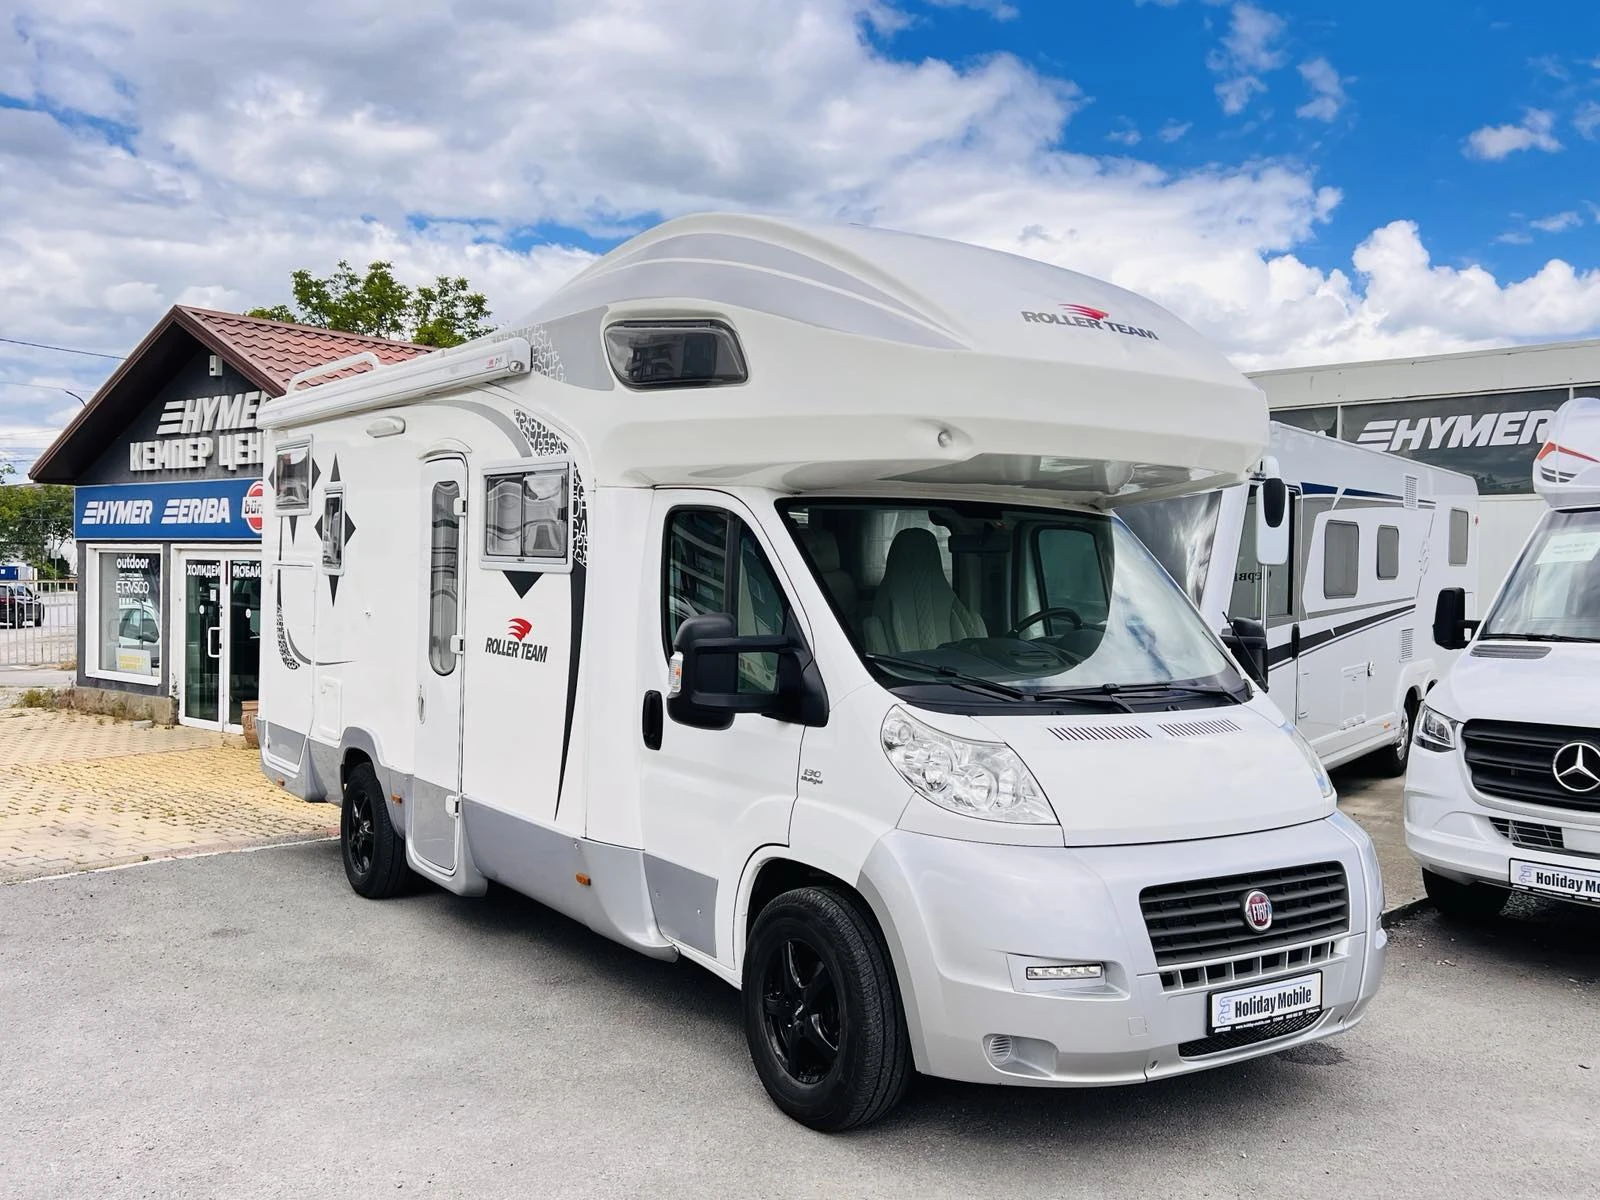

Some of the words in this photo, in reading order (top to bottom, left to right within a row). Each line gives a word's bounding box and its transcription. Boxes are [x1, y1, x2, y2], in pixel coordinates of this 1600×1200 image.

[1020, 310, 1103, 330] ROLLER
[1103, 320, 1160, 341] TEAM
[1389, 409, 1556, 451] HYMER
[129, 436, 214, 471] КЕМПЕР
[218, 431, 264, 471] ЦЕН
[95, 499, 153, 525] HYMER
[177, 497, 231, 524] ERIBA
[116, 554, 150, 569] outdoor
[186, 562, 221, 579] ХОЛИДЕЙ
[232, 562, 262, 578] МОБАЙ
[485, 636, 520, 658] ROLLER
[520, 642, 548, 663] TEAM
[1536, 872, 1583, 892] Holiday
[1251, 902, 1268, 921] FIAT
[1234, 995, 1277, 1018] Holiday
[1277, 985, 1312, 1010] Mobile
